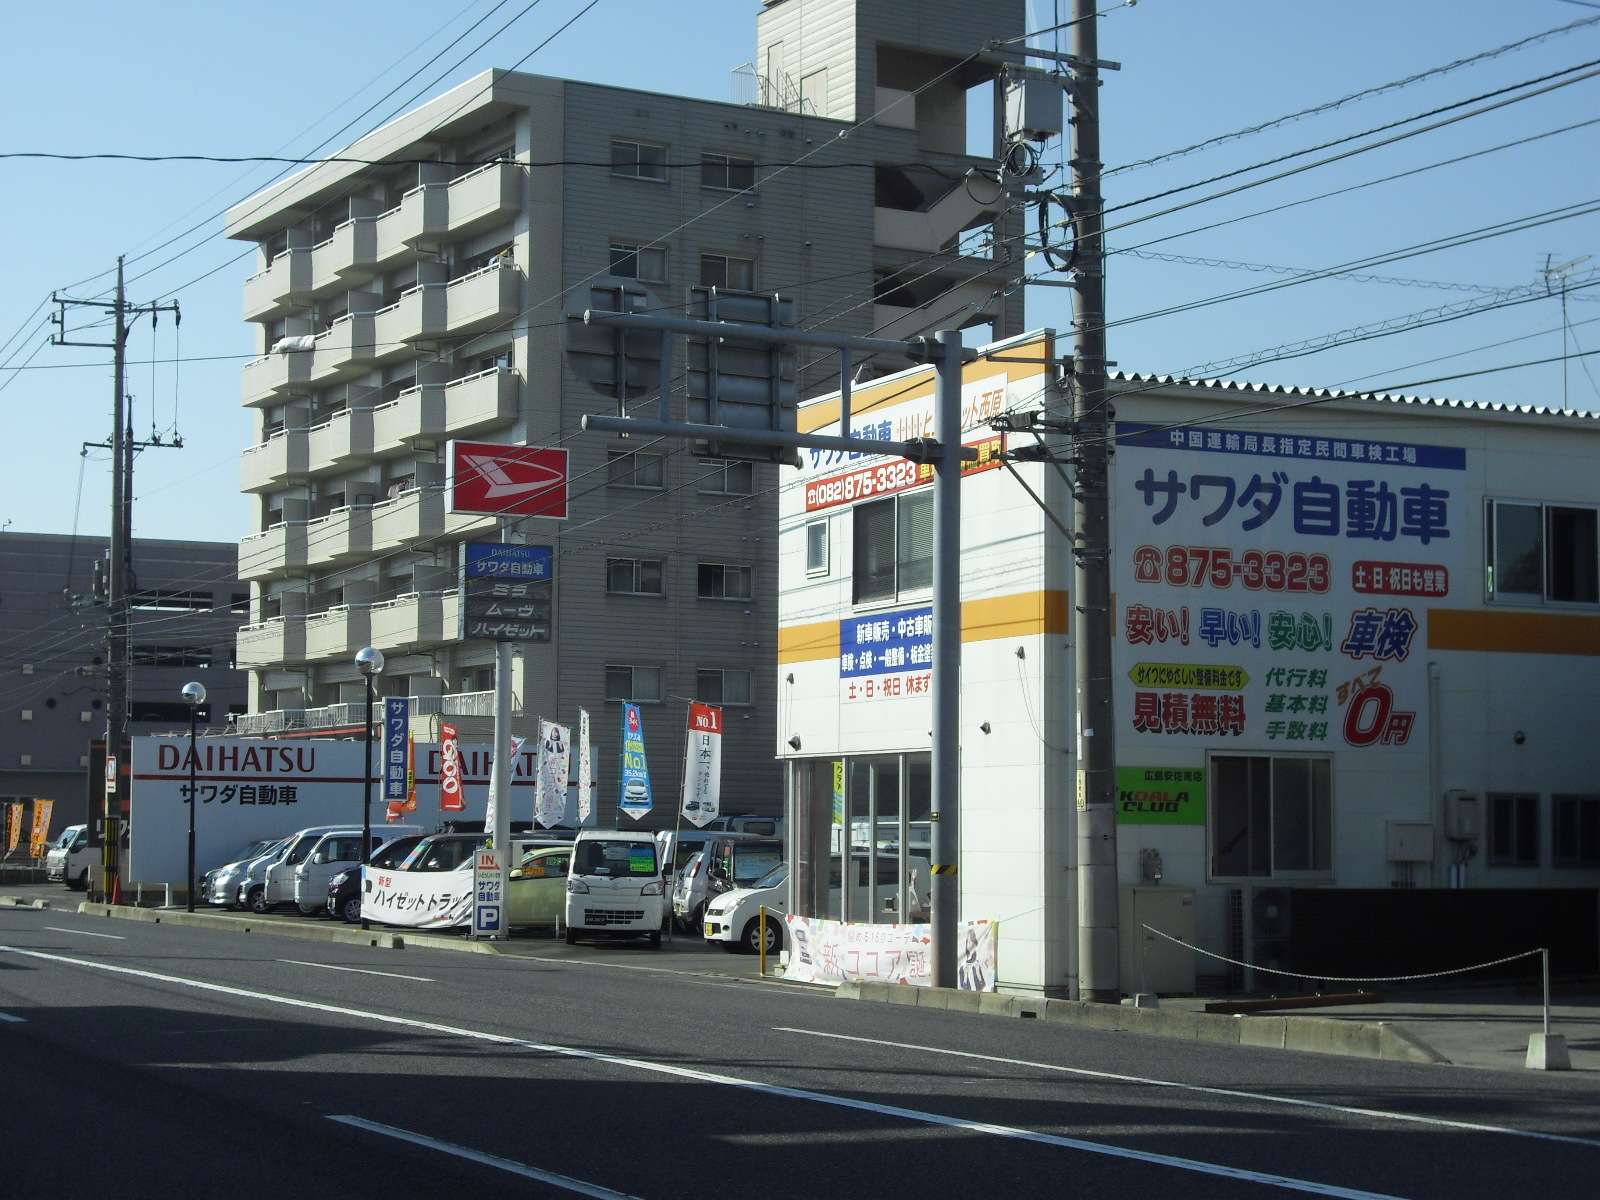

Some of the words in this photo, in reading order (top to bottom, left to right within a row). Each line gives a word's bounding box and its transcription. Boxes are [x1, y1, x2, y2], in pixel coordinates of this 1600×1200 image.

[1169, 429, 1418, 463] 中国運輸局長指定民間車検工場
[815, 461, 917, 506] (082)875-3323
[1135, 468, 1450, 545] サワダ自動車
[491, 549, 530, 558] DAIHATSU
[477, 561, 544, 575] サワダ自動車
[1165, 546, 1332, 594] 875-3323
[1355, 565, 1447, 593] 土・日・祝日も営業
[494, 583, 528, 597] ミラ
[486, 603, 534, 616] ムーヴ
[472, 622, 545, 637] ハイゼット
[1341, 608, 1418, 662] 車検
[842, 643, 933, 672] 車検・点検・一般整備・板金塗
[1265, 667, 1328, 688] 代行料
[1336, 666, 1384, 706] すべて
[1132, 692, 1247, 736] 見積無料
[1265, 694, 1328, 715] 基本料
[1342, 684, 1417, 747] 0円
[1265, 721, 1328, 741] 手数料
[159, 744, 315, 773] DAIHATSU
[389, 702, 404, 796] サワダ自動車
[624, 752, 647, 771] No.1
[1144, 771, 1203, 782] 広島安佐南店
[180, 784, 297, 805] サワダ自動車
[1120, 790, 1190, 803] KOALA
[1123, 801, 1179, 813] CLUB
[481, 855, 494, 865] IN
[378, 876, 392, 888] 新型
[478, 881, 501, 891] サワダ
[478, 892, 500, 901] 自動車
[480, 908, 498, 928] P
